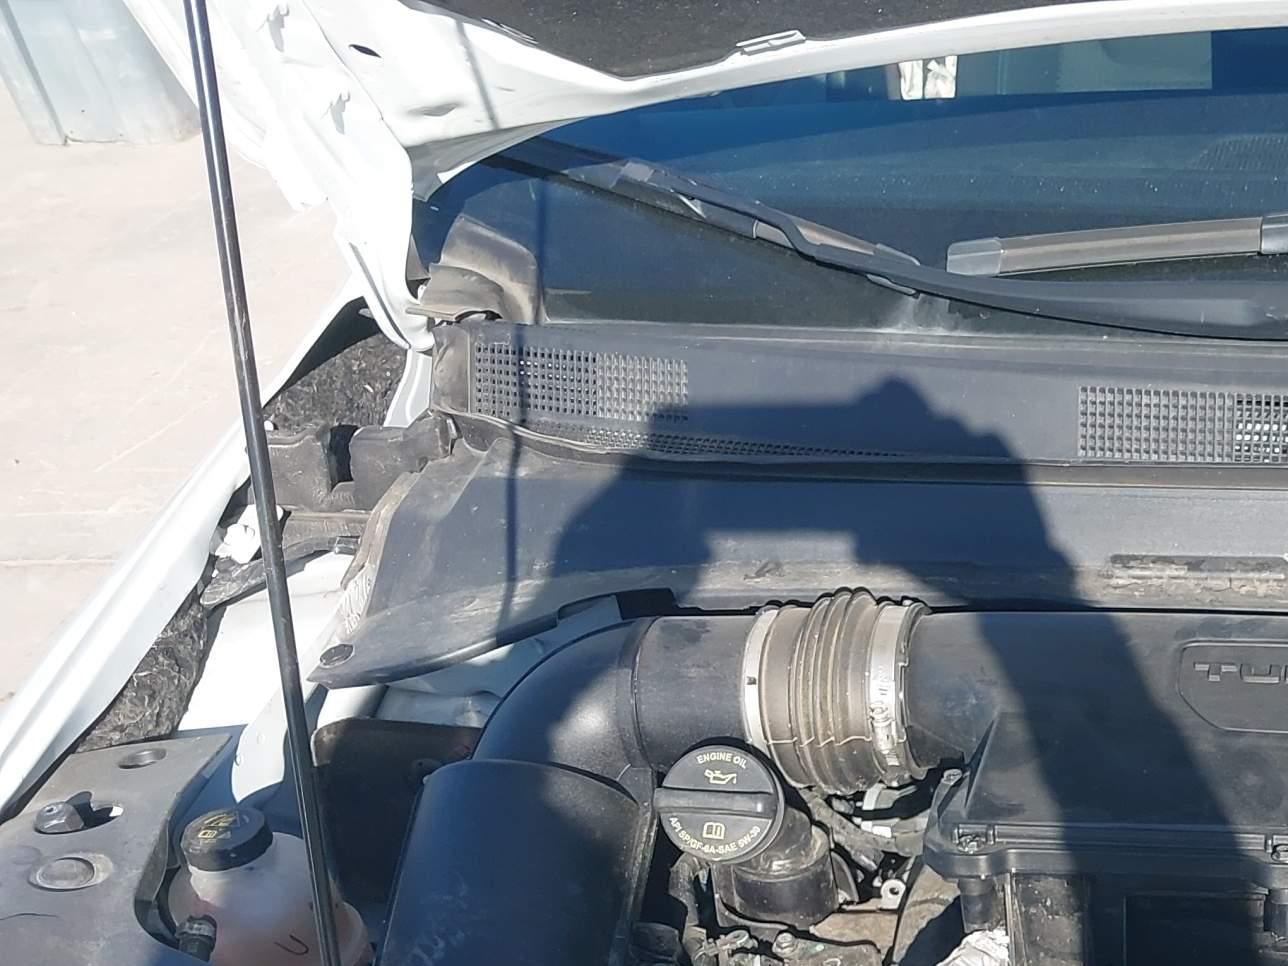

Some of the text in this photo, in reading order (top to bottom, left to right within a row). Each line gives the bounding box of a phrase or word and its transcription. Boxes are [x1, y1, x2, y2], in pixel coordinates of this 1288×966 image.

[697, 752, 747, 769] ENGINE OIL
[669, 817, 681, 833] API
[739, 826, 761, 848] 5W-30
